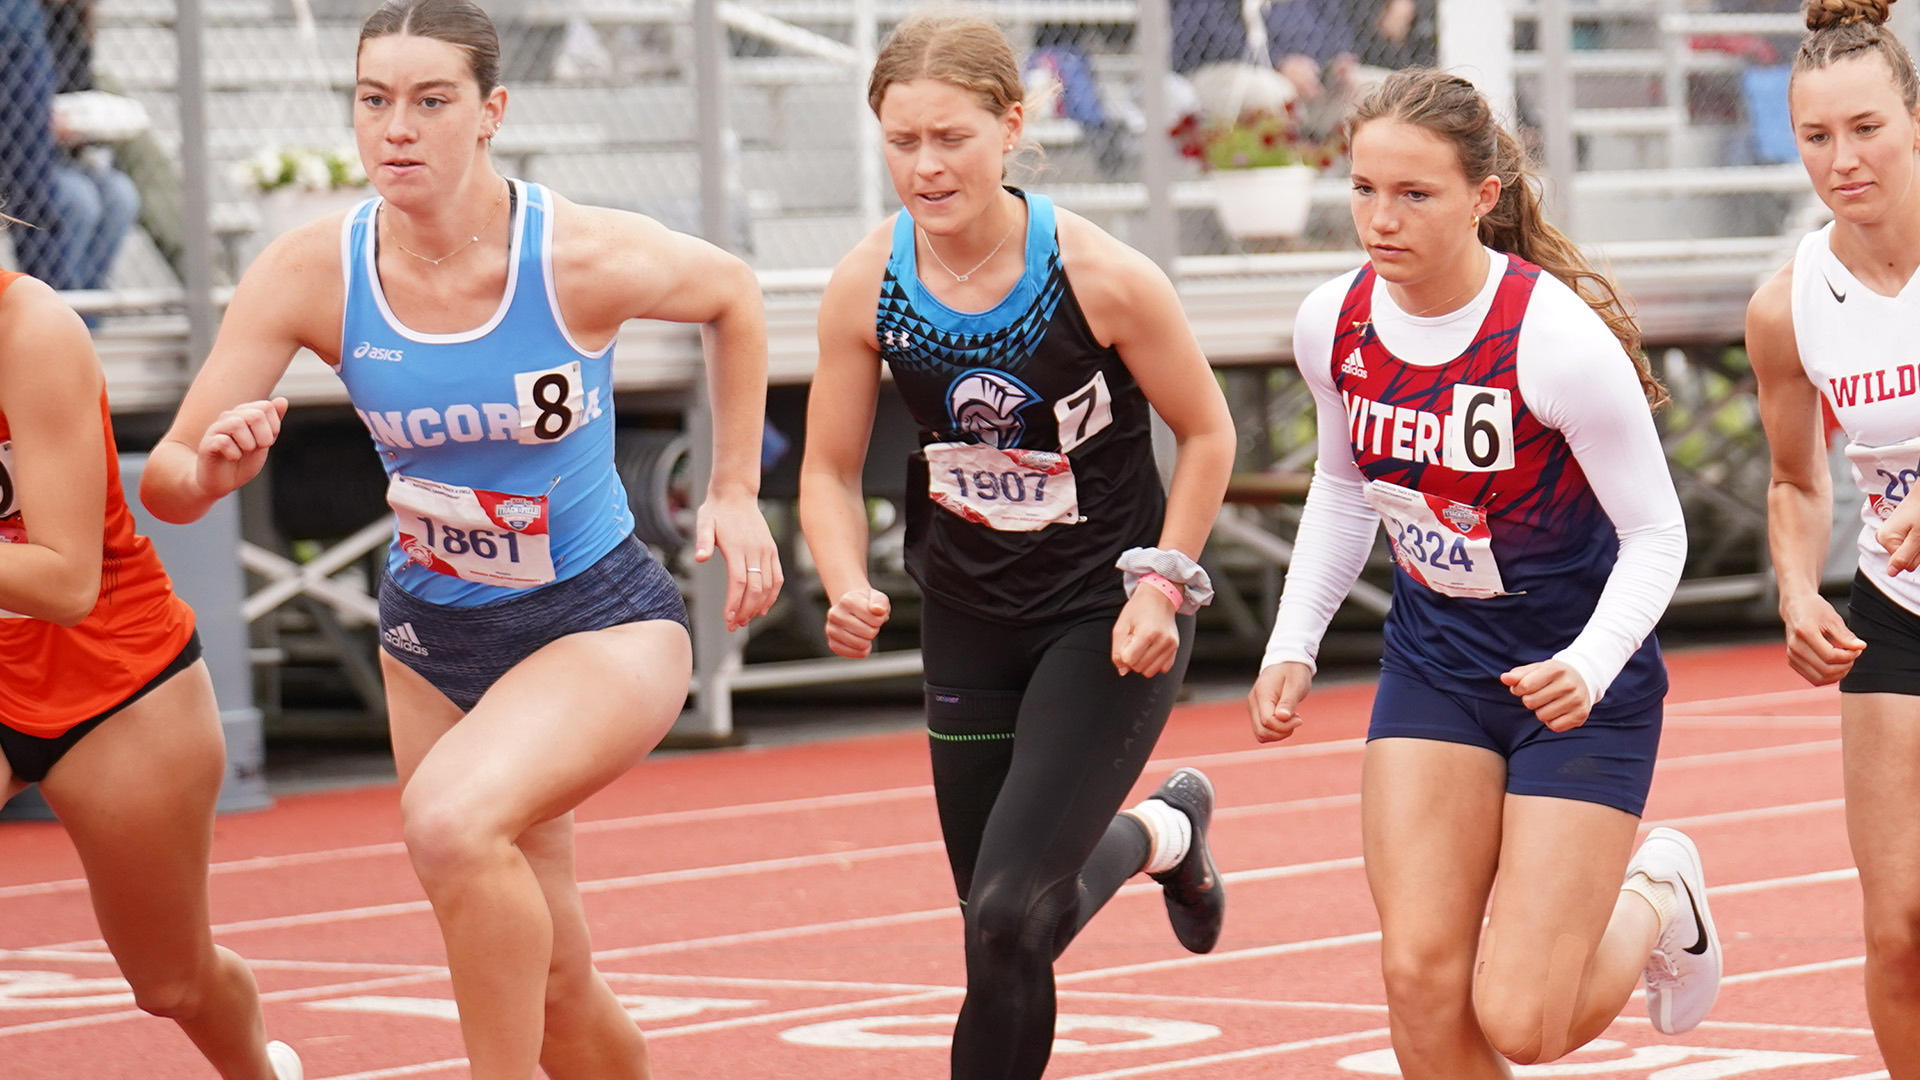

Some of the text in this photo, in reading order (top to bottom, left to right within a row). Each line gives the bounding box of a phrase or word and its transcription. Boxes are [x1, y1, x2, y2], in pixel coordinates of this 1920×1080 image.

[367, 346, 404, 362] asics
[1340, 363, 1368, 380] adidas
[532, 373, 573, 440] 8
[1829, 363, 1920, 408] WILD
[1066, 384, 1097, 442] 7
[1464, 391, 1500, 468] 6
[949, 466, 1049, 503] 1907
[416, 516, 521, 564] 1861
[1391, 517, 1475, 573] 2324
[384, 631, 429, 657] adidas
